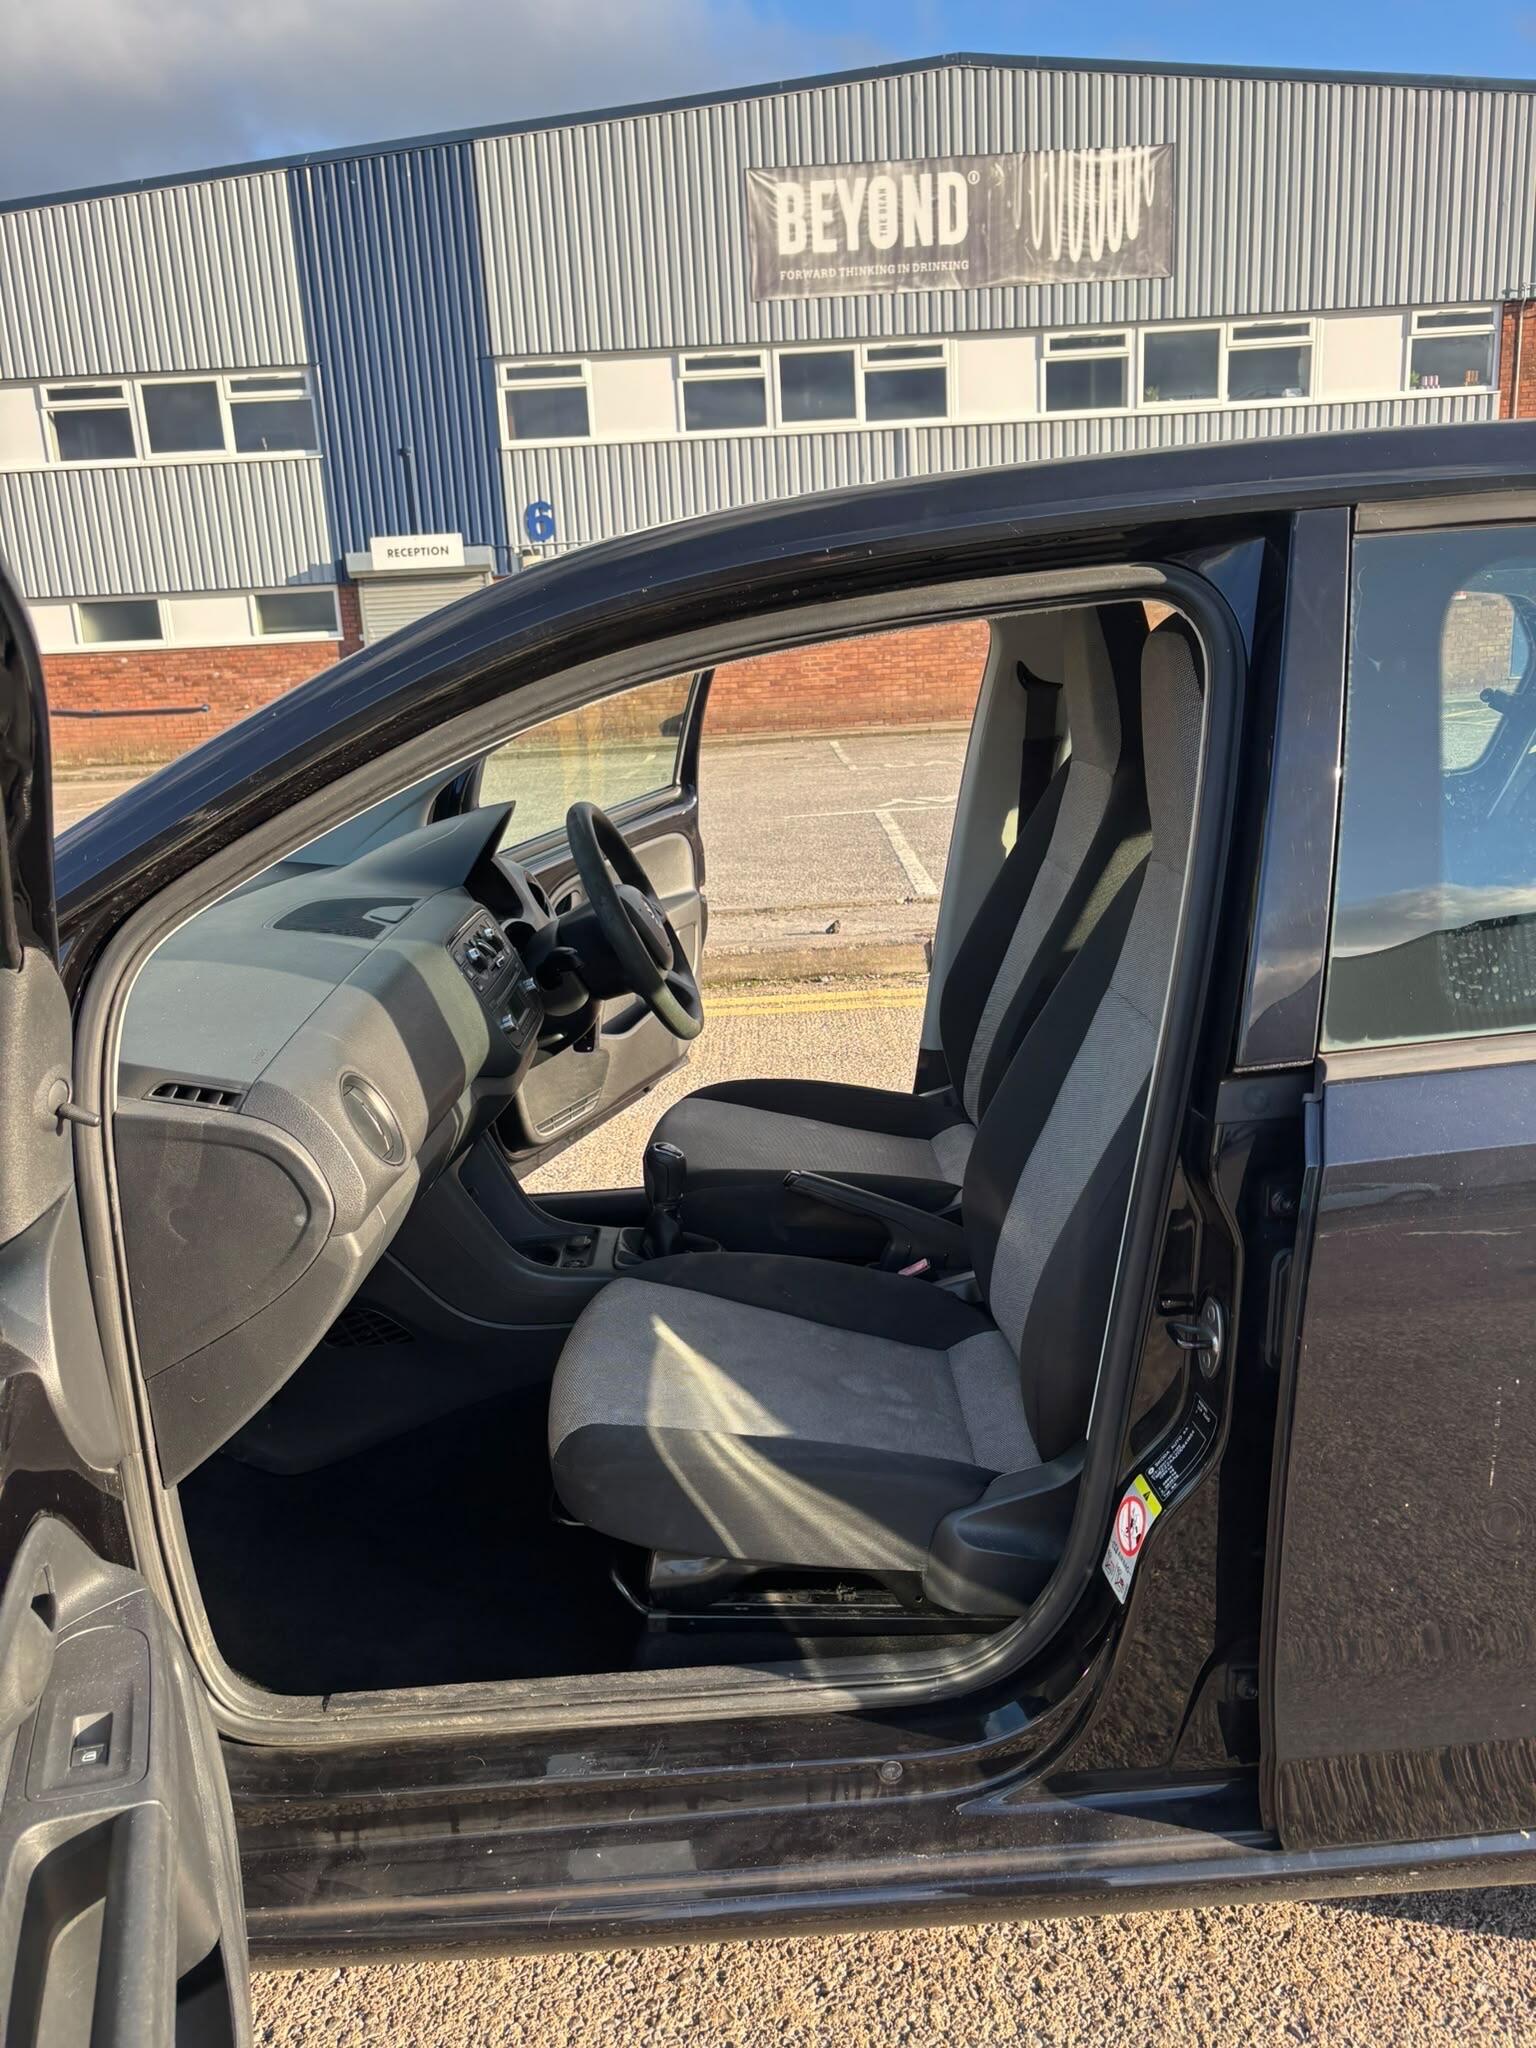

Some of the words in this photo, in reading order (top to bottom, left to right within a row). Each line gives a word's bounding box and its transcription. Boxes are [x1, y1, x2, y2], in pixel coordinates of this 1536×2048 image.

[776, 171, 969, 255] BEYOND
[879, 218, 888, 236] THE
[780, 267, 837, 280] FORWARD
[839, 264, 895, 277] THINKING
[897, 263, 910, 273] IN
[912, 260, 969, 272] DRINKING
[526, 501, 554, 542] 6
[387, 545, 449, 558] RECEPTION
